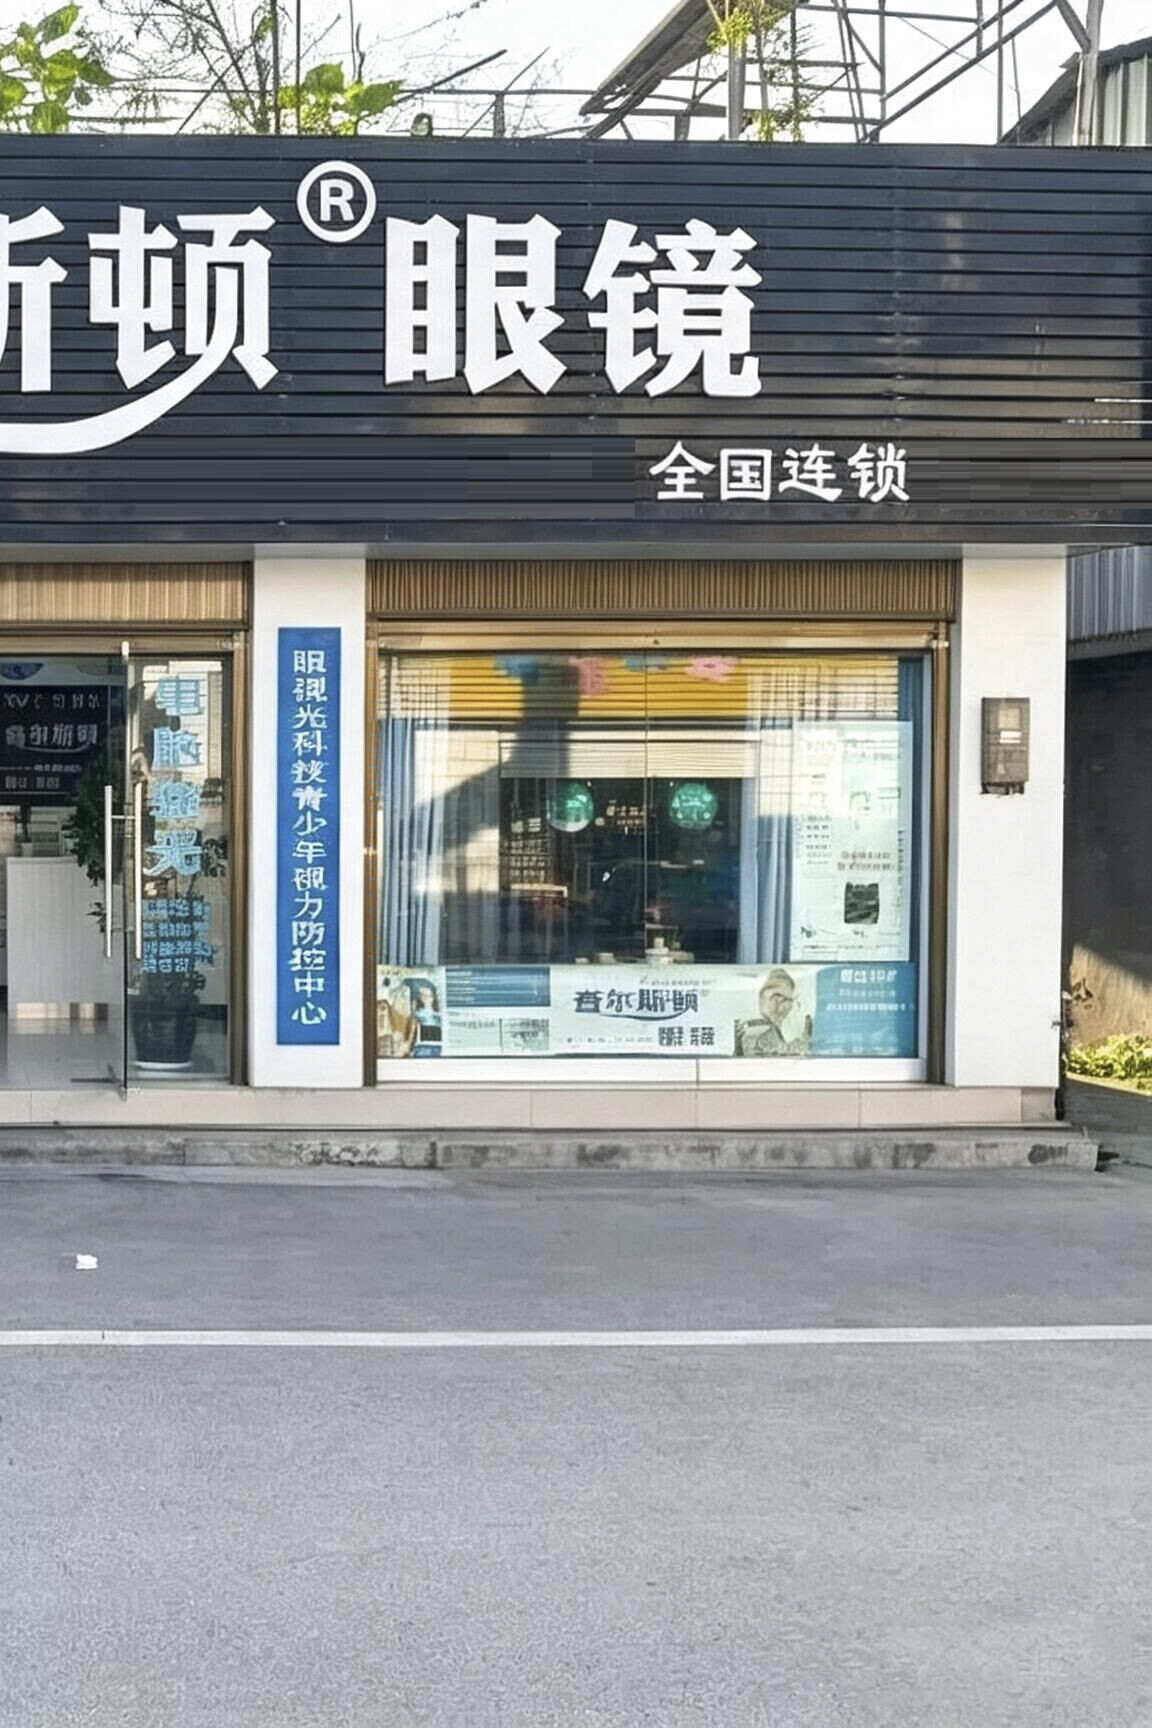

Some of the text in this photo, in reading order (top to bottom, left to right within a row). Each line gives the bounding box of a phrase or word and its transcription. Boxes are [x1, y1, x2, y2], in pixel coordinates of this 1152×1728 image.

[384, 213, 763, 398] 眼镜
[649, 442, 911, 504] 全国连锁
